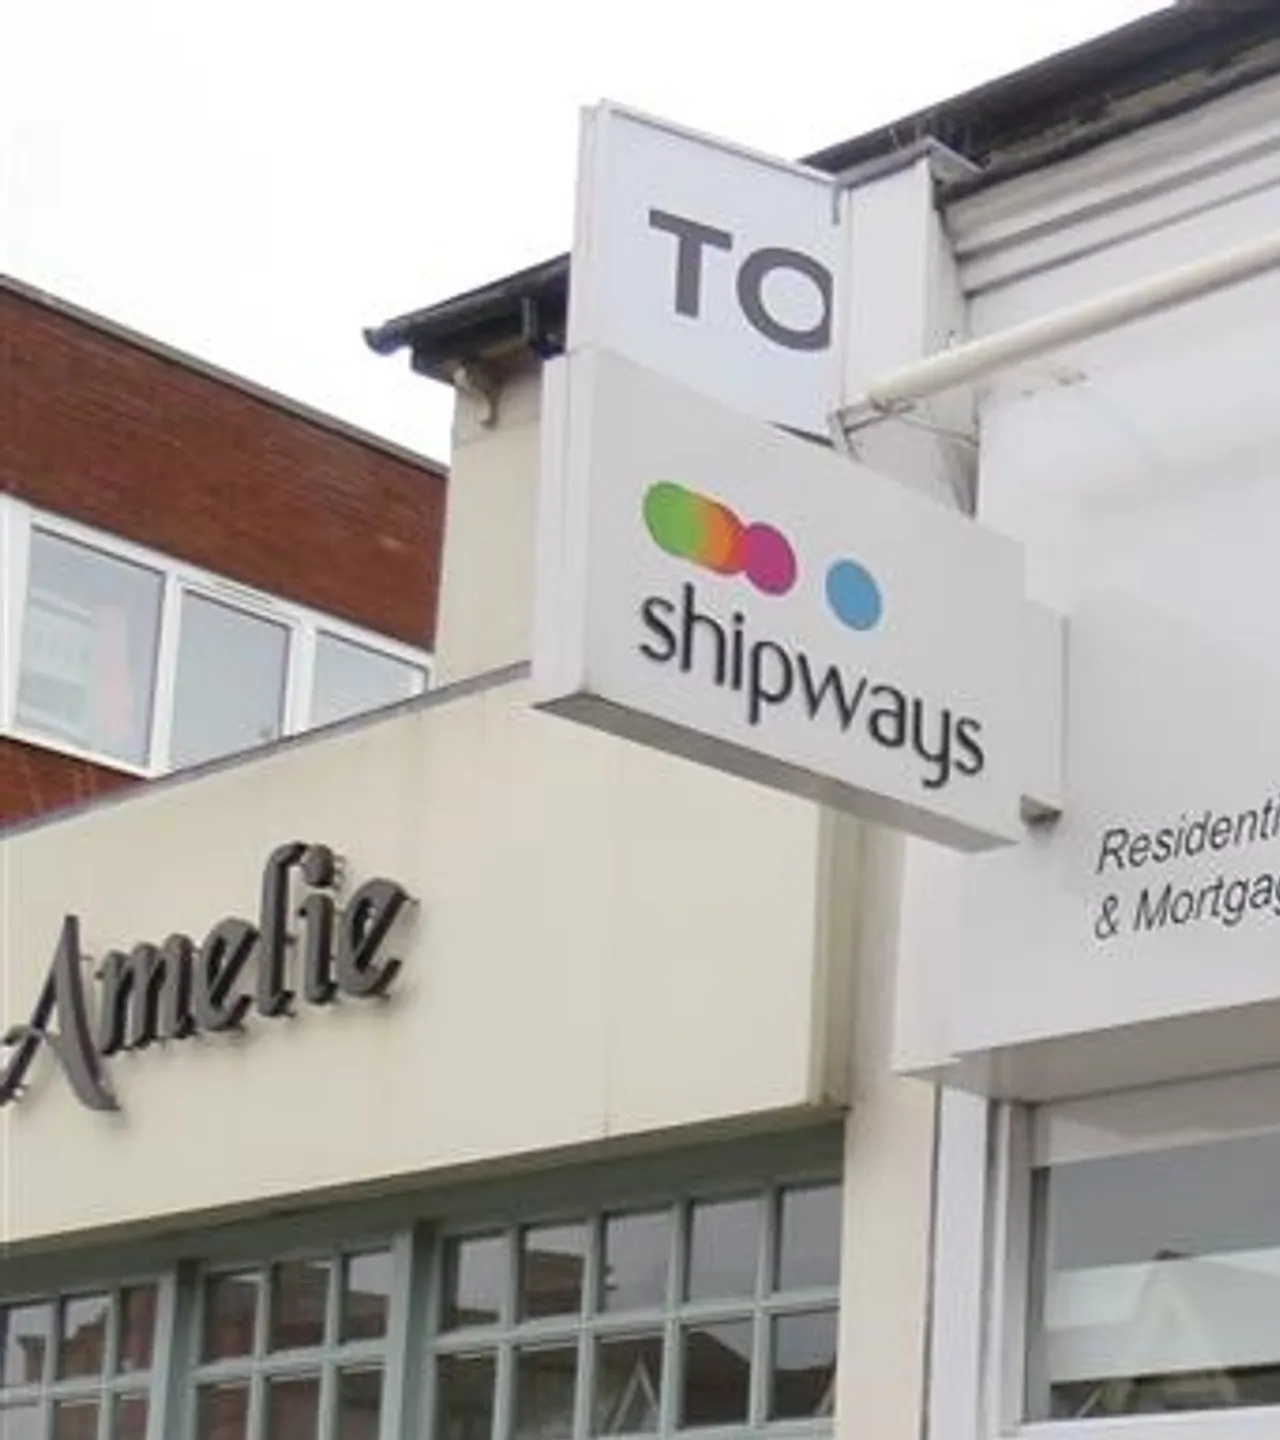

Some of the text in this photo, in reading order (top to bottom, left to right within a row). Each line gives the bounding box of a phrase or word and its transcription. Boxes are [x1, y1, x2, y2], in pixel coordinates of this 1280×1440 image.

[649, 209, 834, 351] TO
[639, 581, 985, 789] shipways
[0, 841, 420, 1111] Amelie
[1094, 895, 1120, 940] &
